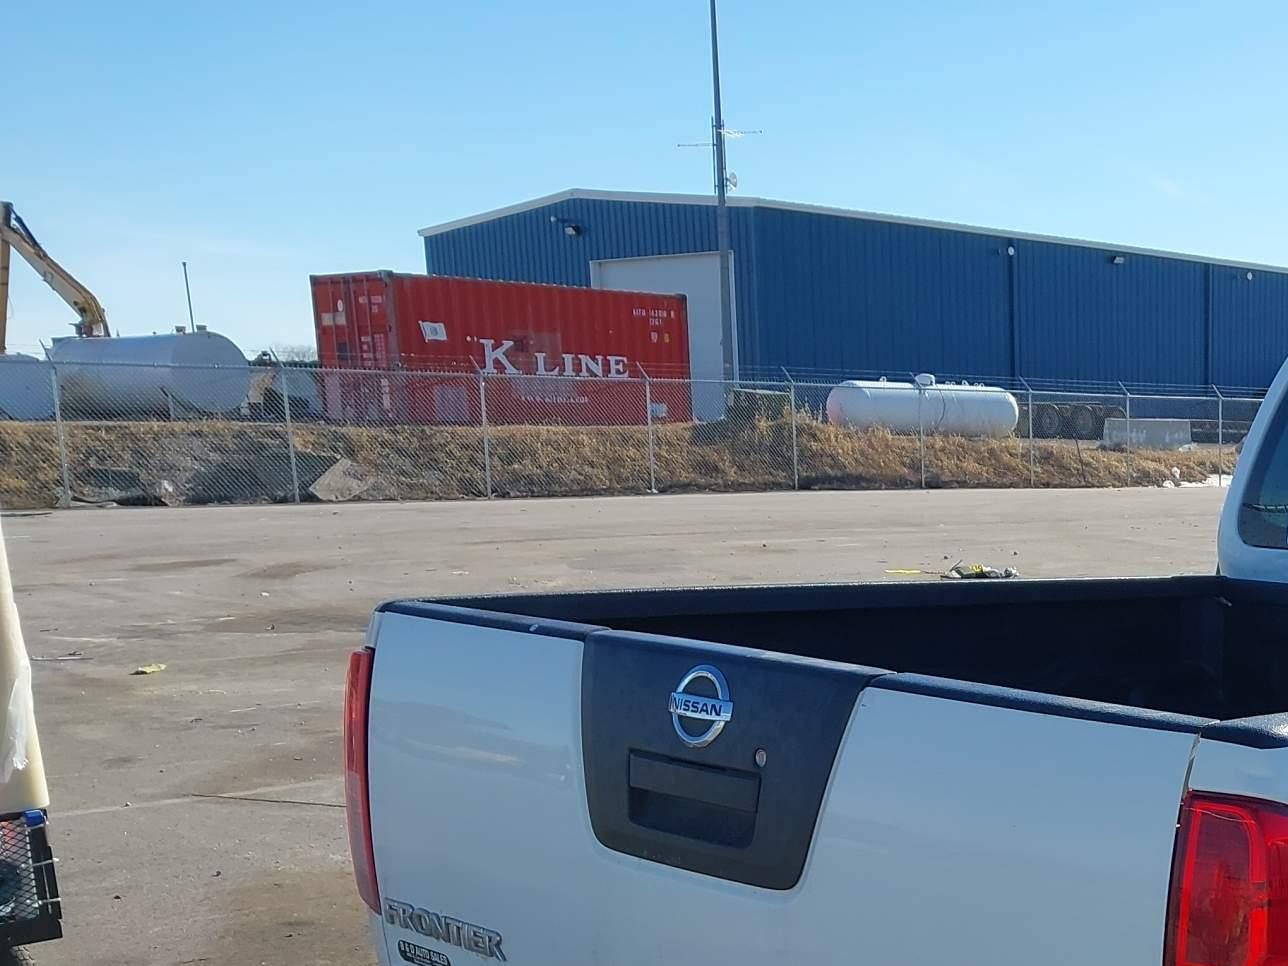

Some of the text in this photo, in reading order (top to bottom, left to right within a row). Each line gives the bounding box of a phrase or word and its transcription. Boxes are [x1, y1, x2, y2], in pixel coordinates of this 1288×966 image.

[534, 352, 629, 378] LINE
[672, 697, 723, 717] NISSAN
[384, 897, 507, 961] FRONTIER
[415, 946, 430, 960] AUTO
[430, 951, 448, 965] SALES
